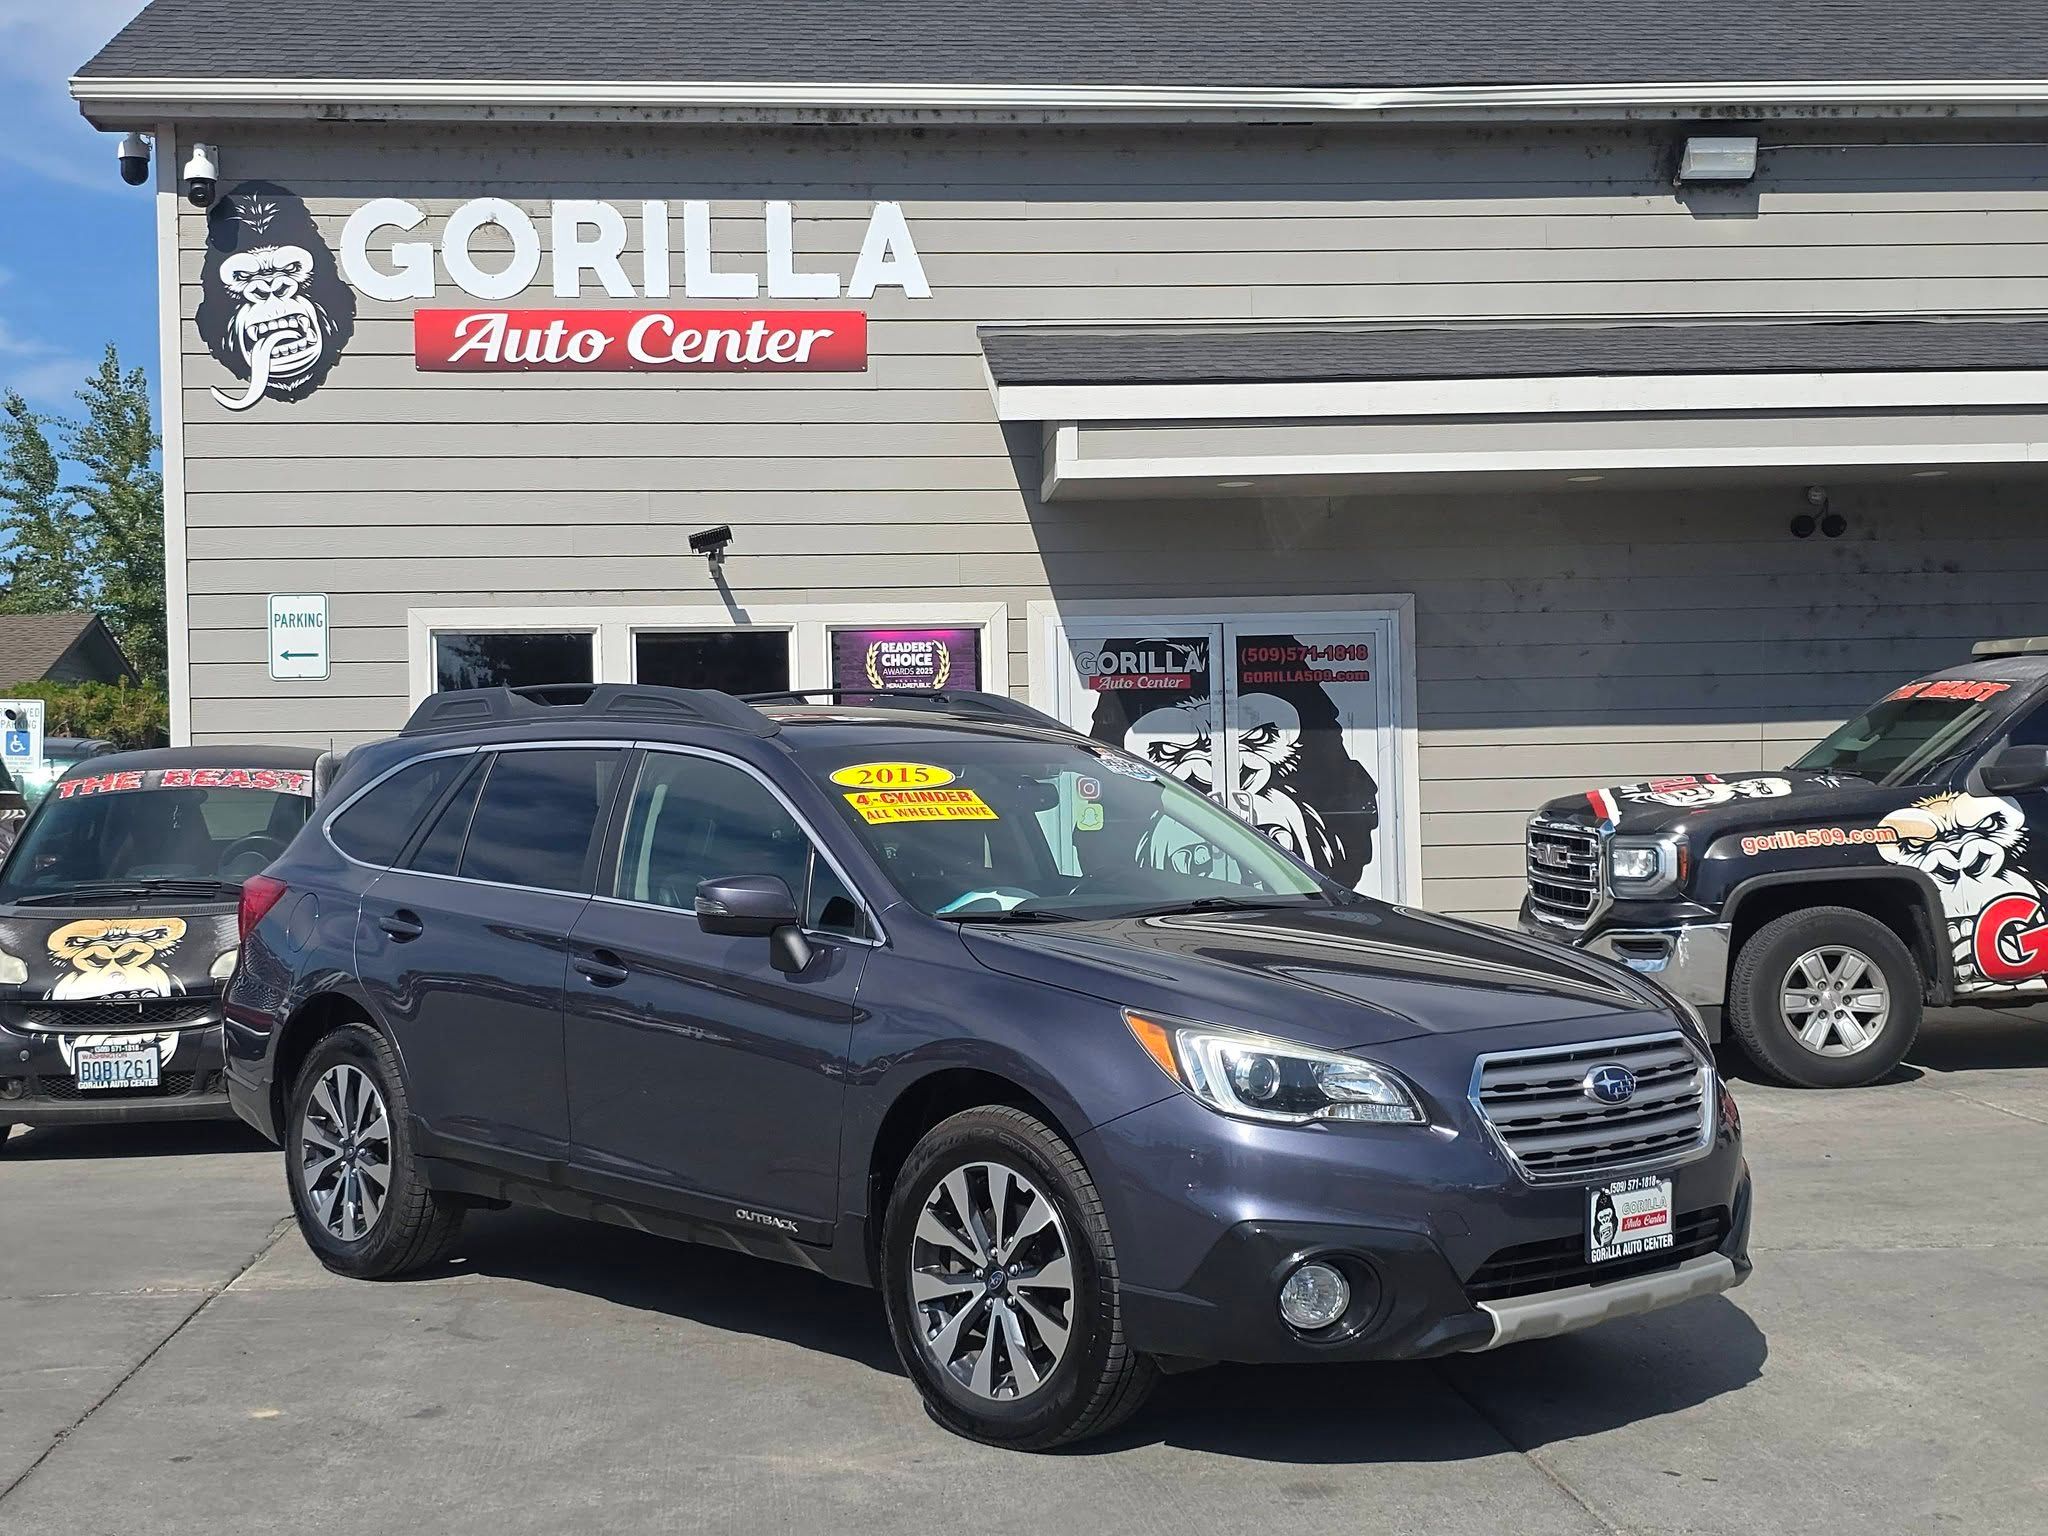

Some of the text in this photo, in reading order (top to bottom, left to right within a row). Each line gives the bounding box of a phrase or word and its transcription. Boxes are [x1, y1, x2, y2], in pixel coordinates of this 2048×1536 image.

[339, 197, 933, 301] GORILLA
[447, 313, 834, 364] Auto Center
[274, 613, 323, 628] PARKING
[881, 642, 934, 653] READERS'
[1241, 644, 1368, 665] (509)571-1818
[881, 653, 933, 667] CHOICE
[1075, 651, 1203, 675] GORILLA
[883, 667, 934, 676] AWARDS 2025
[1243, 670, 1369, 683] GORILLA509.com
[1098, 676, 1184, 690] Auto Center
[56, 768, 312, 800] THE BEAST
[857, 768, 930, 785] 2015
[856, 791, 974, 806] 4-CYLINDER
[866, 806, 993, 820] ALL WHEEL DRIVE
[1741, 828, 1898, 855] gorilla509.com
[81, 1059, 152, 1081] BQB1261
[78, 1078, 158, 1090] GORILLA AUTO CENTER
[1610, 1175, 1657, 1194] (509) 571-1818
[1621, 1196, 1667, 1216] GORILLA
[735, 1208, 798, 1232] OUTBACK
[1624, 1214, 1666, 1230] Auto Center
[1591, 1233, 1673, 1263] GORILLA AUTO CENTER
